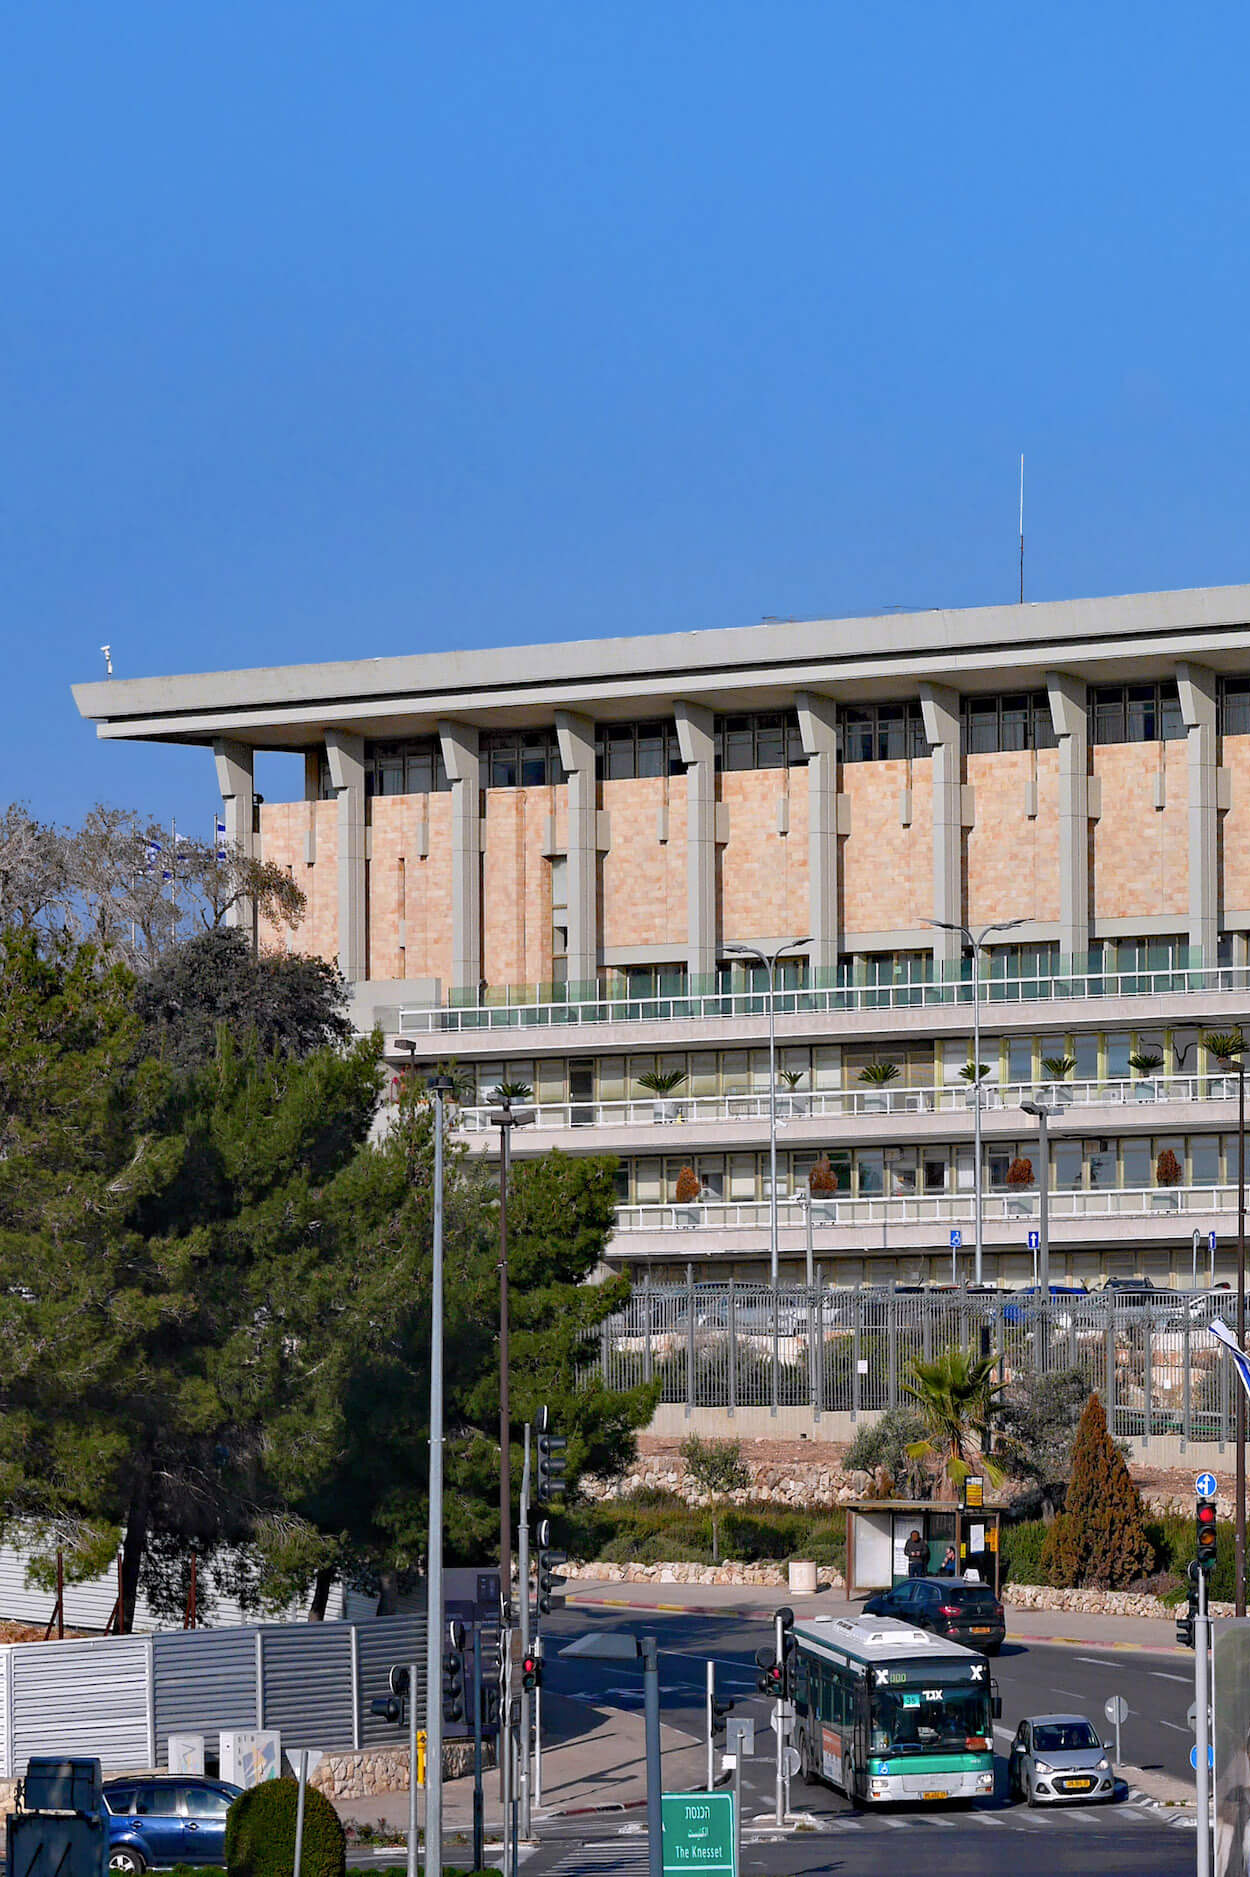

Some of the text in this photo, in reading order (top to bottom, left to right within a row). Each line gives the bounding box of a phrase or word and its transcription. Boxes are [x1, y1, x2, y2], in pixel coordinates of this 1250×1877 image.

[685, 1806, 711, 1820] הכנסת
[675, 1846, 723, 1859] The Knesset
